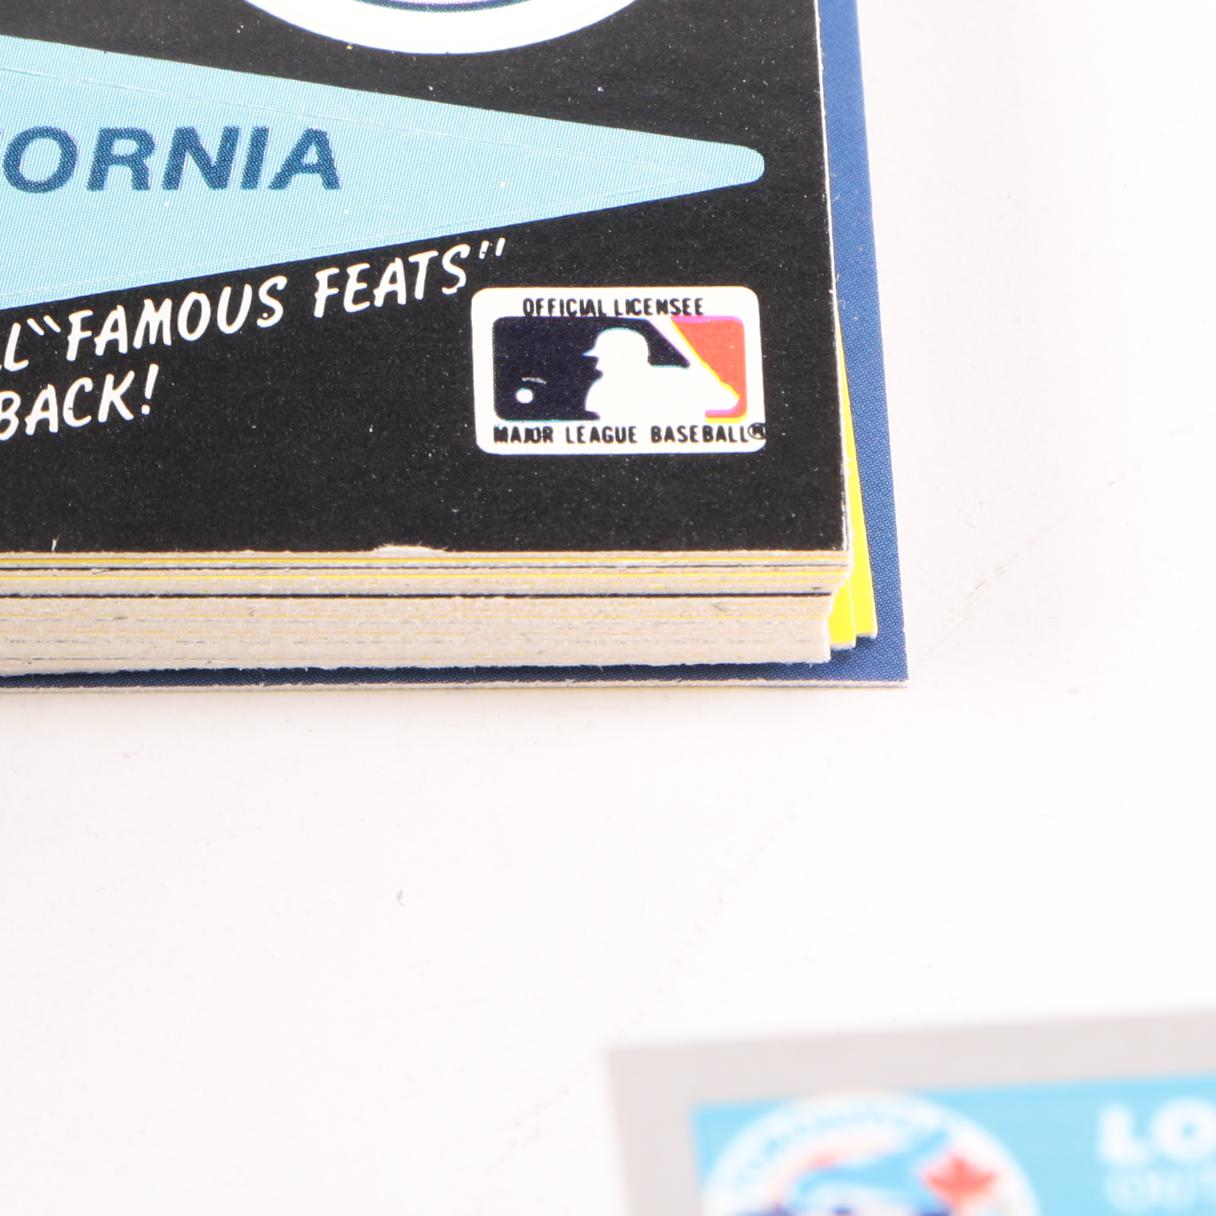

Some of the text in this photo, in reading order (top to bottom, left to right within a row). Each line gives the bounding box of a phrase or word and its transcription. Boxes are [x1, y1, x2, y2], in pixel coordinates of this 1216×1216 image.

[522, 297, 704, 317] OFFICIAL LICENSEE
[493, 425, 554, 444] MAJOR
[566, 425, 638, 443] LEAGUE
